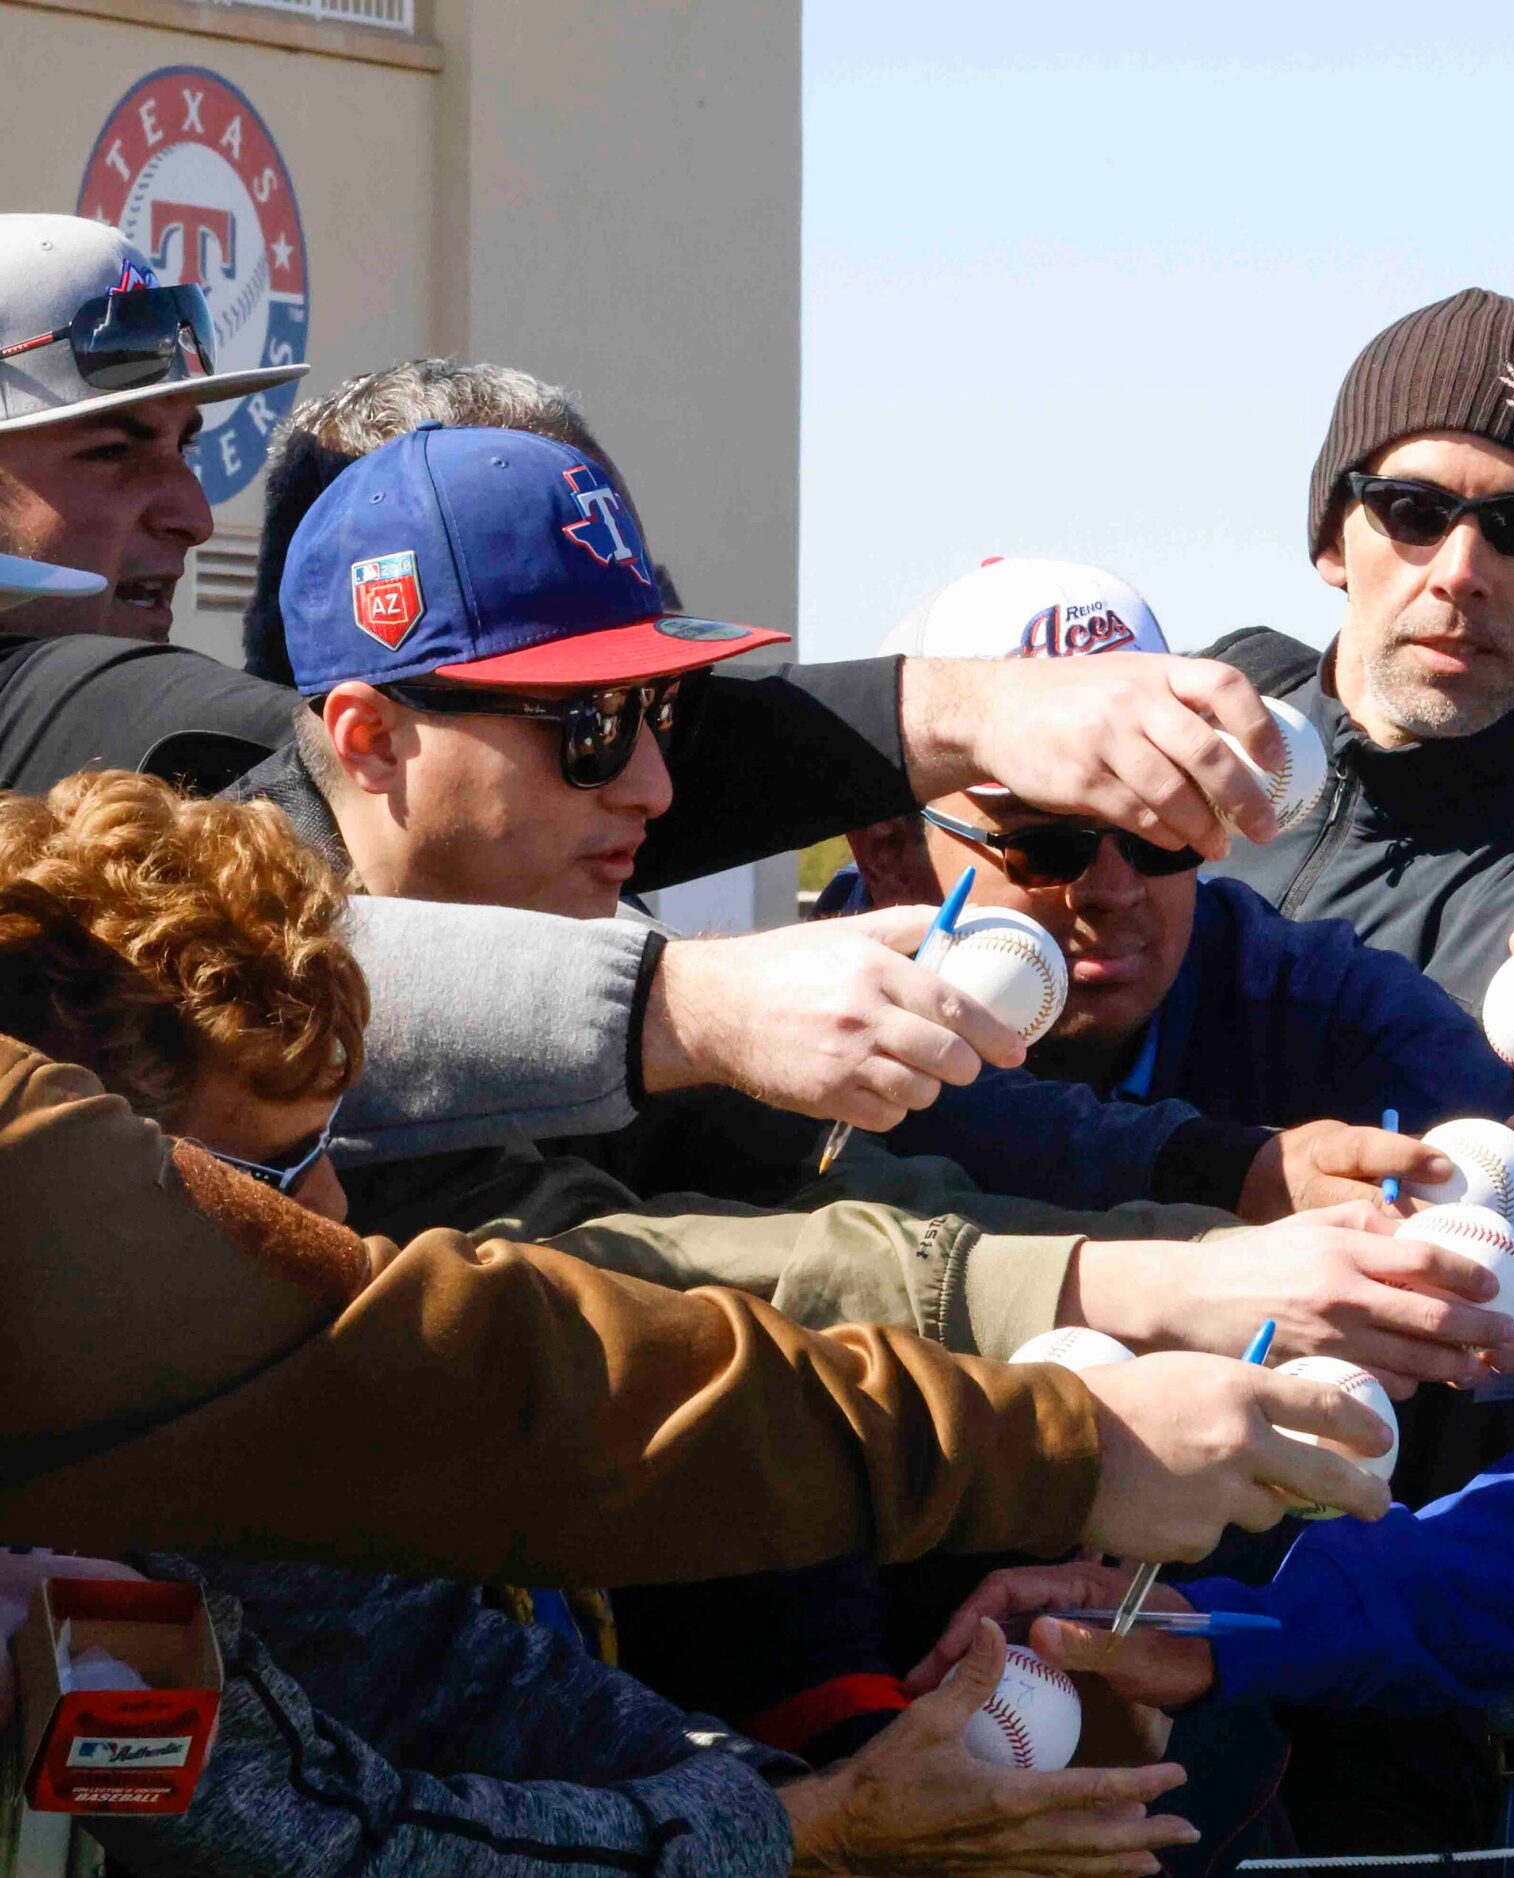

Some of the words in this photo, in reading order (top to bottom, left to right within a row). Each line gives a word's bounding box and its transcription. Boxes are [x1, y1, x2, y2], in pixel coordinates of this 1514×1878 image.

[105, 88, 278, 203] TEXAS
[574, 487, 633, 563] T
[372, 592, 402, 617] AZ
[1065, 600, 1103, 622] RENO
[1010, 604, 1135, 657] Aces
[74, 1793, 160, 1803] BASEBALL
